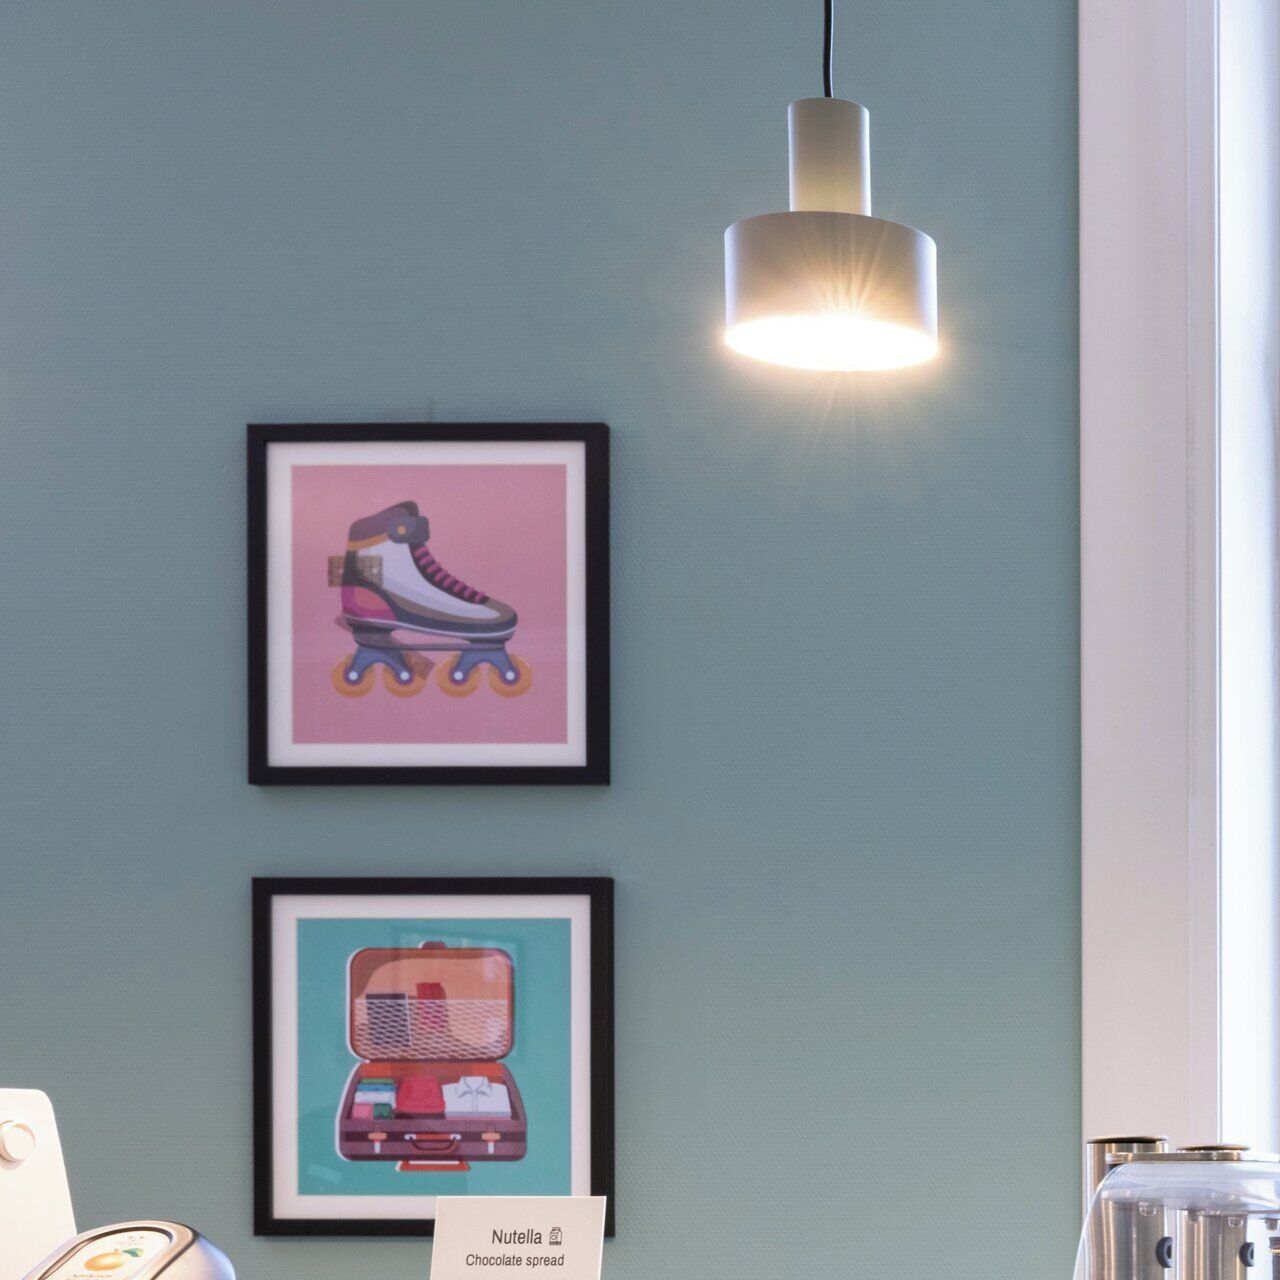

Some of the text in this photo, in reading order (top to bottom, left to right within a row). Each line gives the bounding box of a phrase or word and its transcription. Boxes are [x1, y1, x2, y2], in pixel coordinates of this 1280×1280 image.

[492, 1228, 542, 1245] Nutella
[466, 1254, 565, 1268] Chocolate spread
